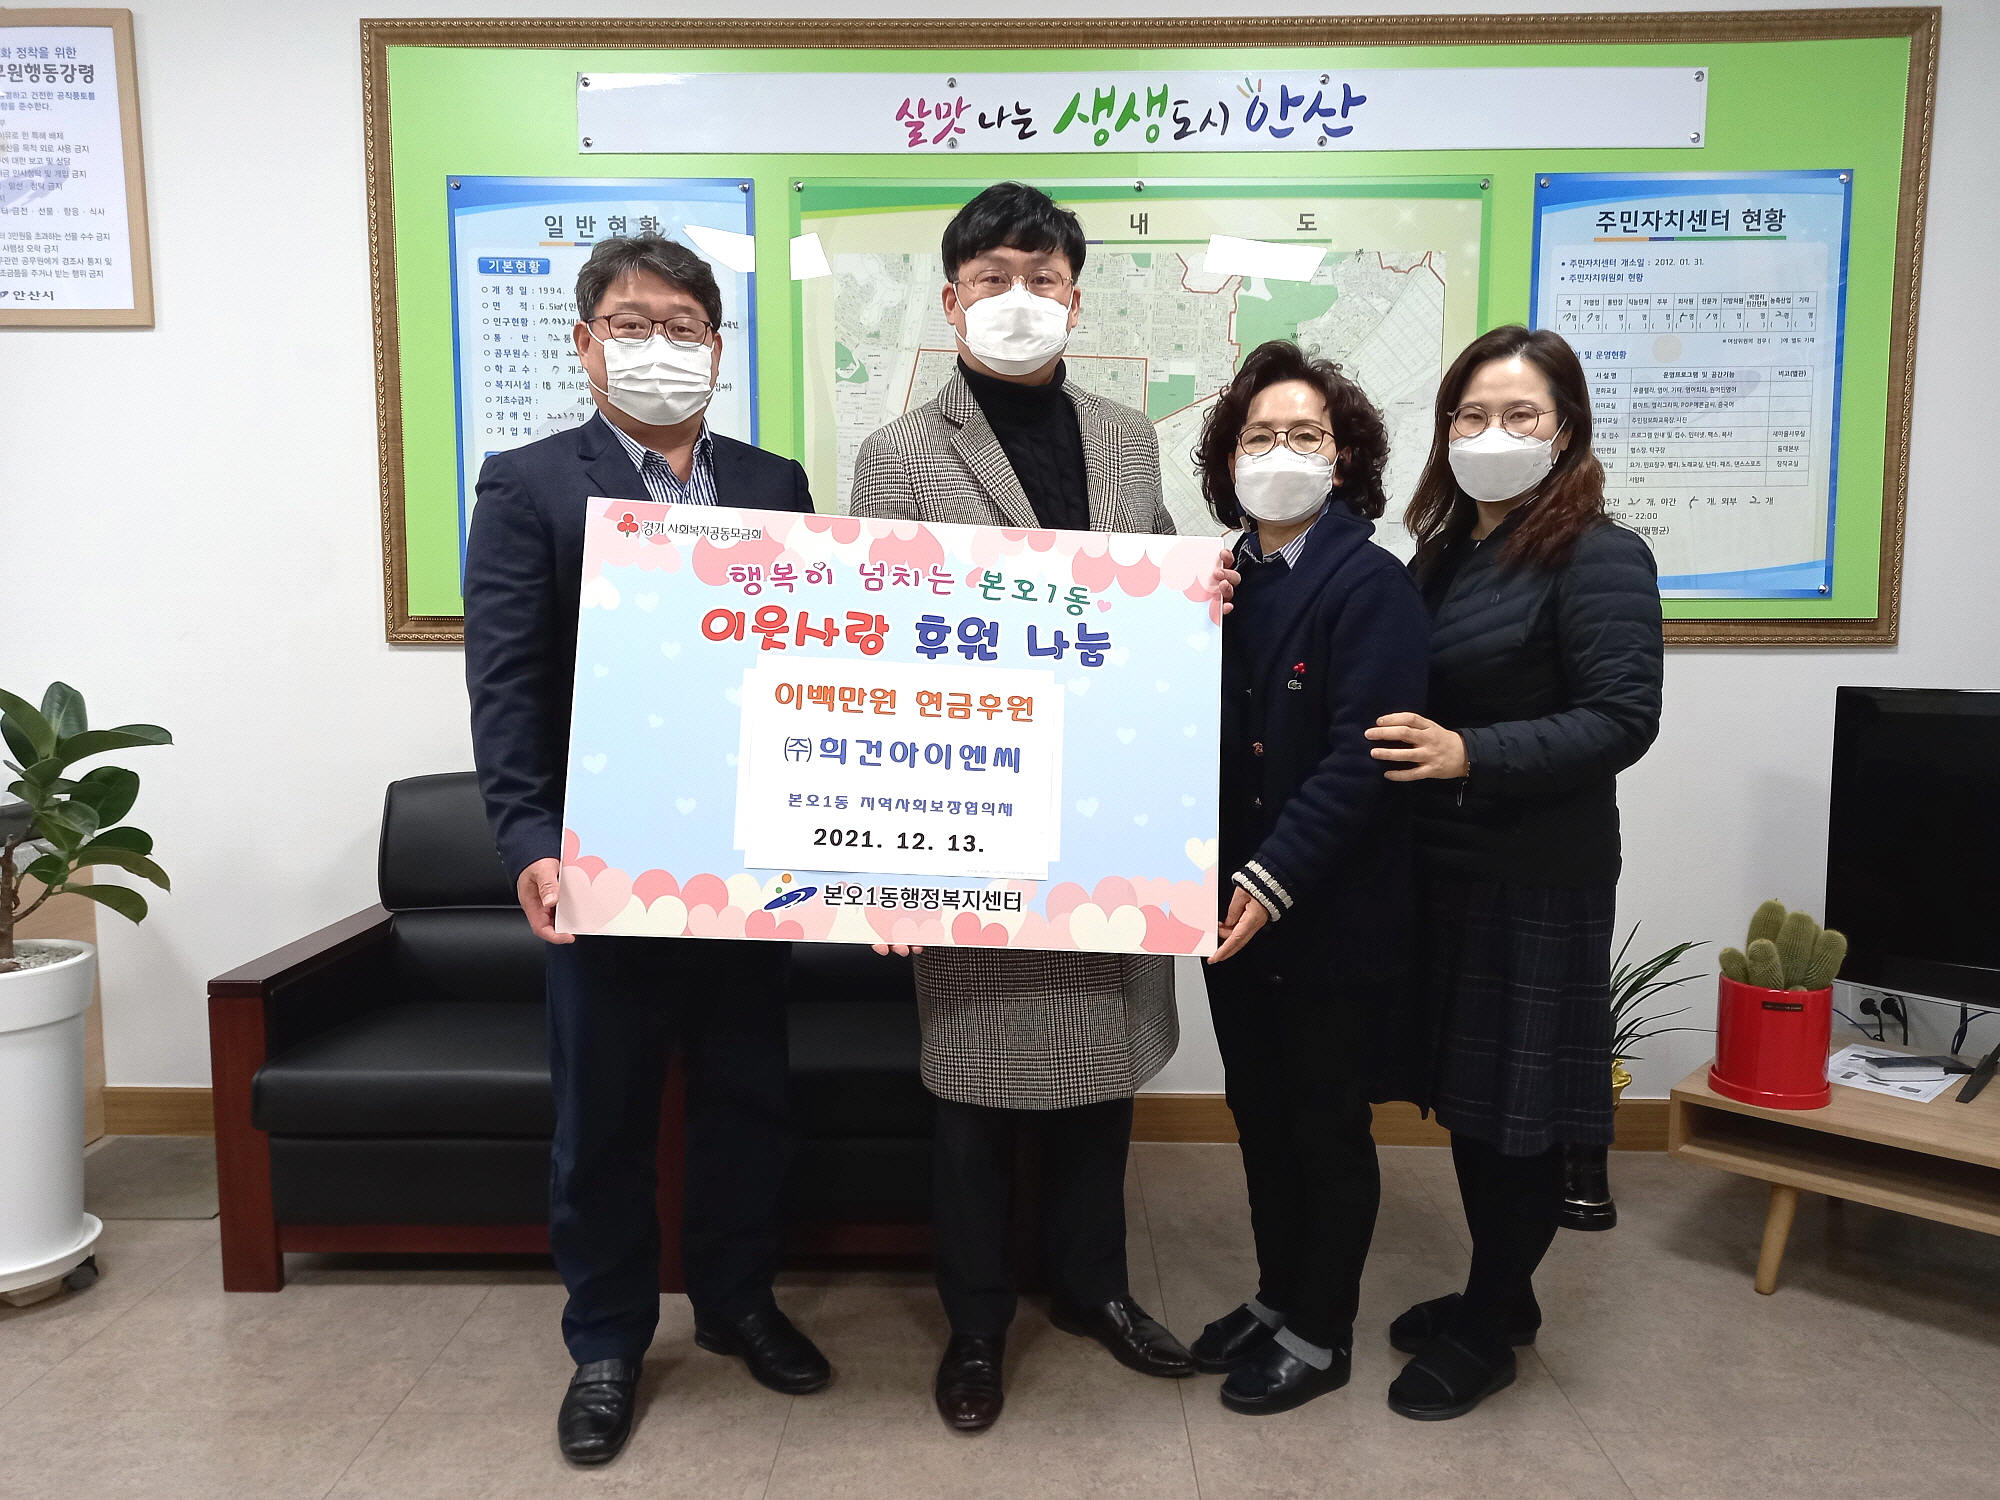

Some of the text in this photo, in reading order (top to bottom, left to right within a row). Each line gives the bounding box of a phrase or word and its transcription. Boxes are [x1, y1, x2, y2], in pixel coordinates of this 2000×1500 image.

[16, 46, 49, 59] 정착을
[55, 46, 77, 59] 위한
[895, 96, 971, 147] 살맛
[978, 101, 1038, 131] 나는
[1245, 83, 1367, 139] 안산
[74, 145, 90, 153] 금지
[29, 157, 43, 165] 보고
[46, 157, 53, 166] 및
[56, 157, 71, 166] 상담
[45, 170, 51, 178] 및
[72, 170, 87, 178] 금지
[48, 182, 63, 191] 금지
[90, 208, 105, 216] 식사
[1130, 213, 1148, 235] 내
[1297, 213, 1317, 231] 도
[1595, 208, 1787, 233] 주민자치센터 현황
[64, 232, 78, 241] 선물
[80, 233, 94, 241] 수수
[96, 233, 110, 241] 금지
[43, 245, 59, 253] 금지
[105, 257, 112, 266] 및
[1570, 258, 1704, 268] 주민자치센터 개소일 2012. 01. 31.
[488, 260, 541, 274] 기본현황
[31, 270, 52, 278] 주거나
[89, 270, 104, 278] 금지
[1569, 273, 1644, 283] 주민자치위원회 현황
[13, 290, 54, 301] 안산시
[539, 287, 565, 295] 1994.
[493, 302, 528, 311] 면 적
[493, 317, 529, 327] 인구현황
[521, 333, 529, 343] 반
[494, 348, 530, 359] 공무원수
[541, 349, 559, 359] 정원
[1584, 350, 1627, 360] 및 운영현황
[495, 380, 531, 390] 복지시설
[496, 396, 532, 405] 기초수급자
[1660, 497, 1677, 507] 야간
[1721, 497, 1738, 506] 외부
[1765, 497, 1774, 506] 개
[1635, 512, 1658, 520] 22:00
[643, 521, 762, 541] 경기 사회복지공동모금회
[859, 563, 956, 596] 넘치는
[978, 569, 1092, 617] 본오1동
[701, 604, 1113, 668] 이웃사랑 후원 나눔
[774, 682, 897, 716] 이백만원
[819, 736, 1021, 774] 희건아이엔씨
[788, 793, 1013, 817] 본오1동 지역사회보장협의체
[813, 828, 984, 854] 2021. 12. 13.
[823, 885, 1023, 913] 본오1동행정복지센터
